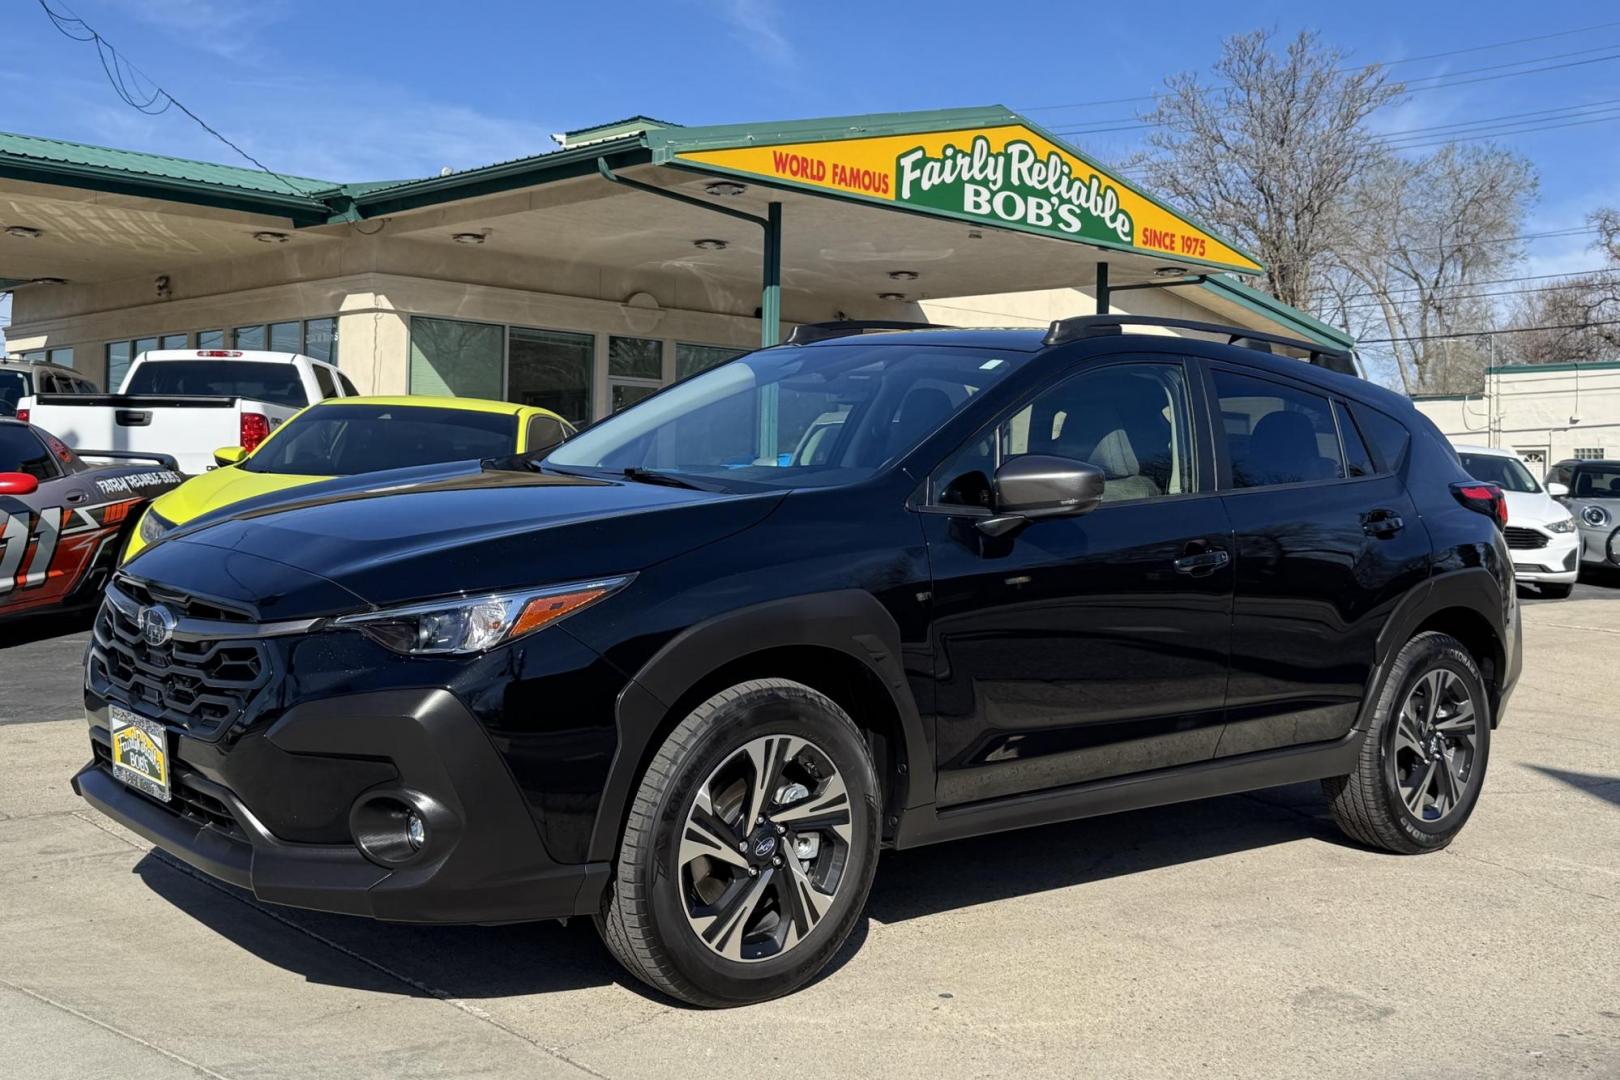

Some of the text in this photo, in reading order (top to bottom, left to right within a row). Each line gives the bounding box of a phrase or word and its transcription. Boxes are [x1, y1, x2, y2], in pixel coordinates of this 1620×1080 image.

[773, 150, 889, 195] WORLD FAMOUS
[900, 138, 1132, 242] Fairly Reliable
[964, 183, 1082, 233] BOB'S
[1142, 227, 1206, 257] SINCE 1975
